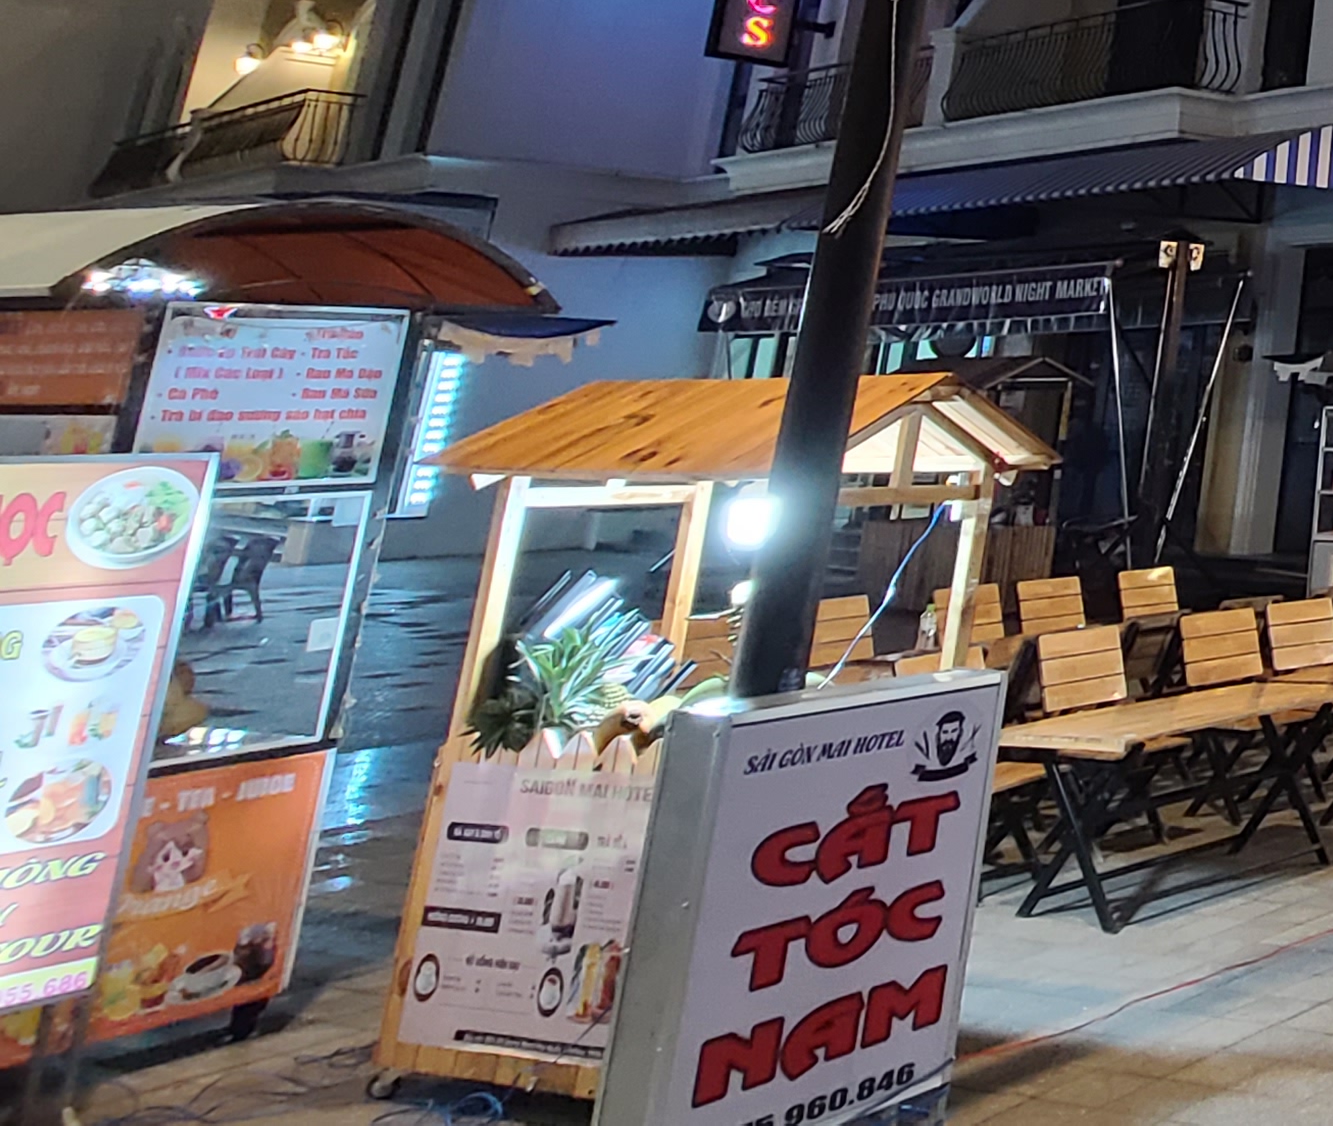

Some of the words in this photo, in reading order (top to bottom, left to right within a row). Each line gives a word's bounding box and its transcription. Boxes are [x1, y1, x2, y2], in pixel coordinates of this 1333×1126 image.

[931, 282, 1013, 308] GRANDWORLD
[1015, 280, 1053, 303] NIGHT
[1055, 277, 1107, 299] MARKET
[0, 491, 67, 567] ỌC
[816, 738, 854, 762] MAI
[852, 730, 905, 756] HOTEL
[751, 782, 961, 888] CẮT
[731, 879, 946, 992] TÓC
[691, 964, 949, 1109] NAM
